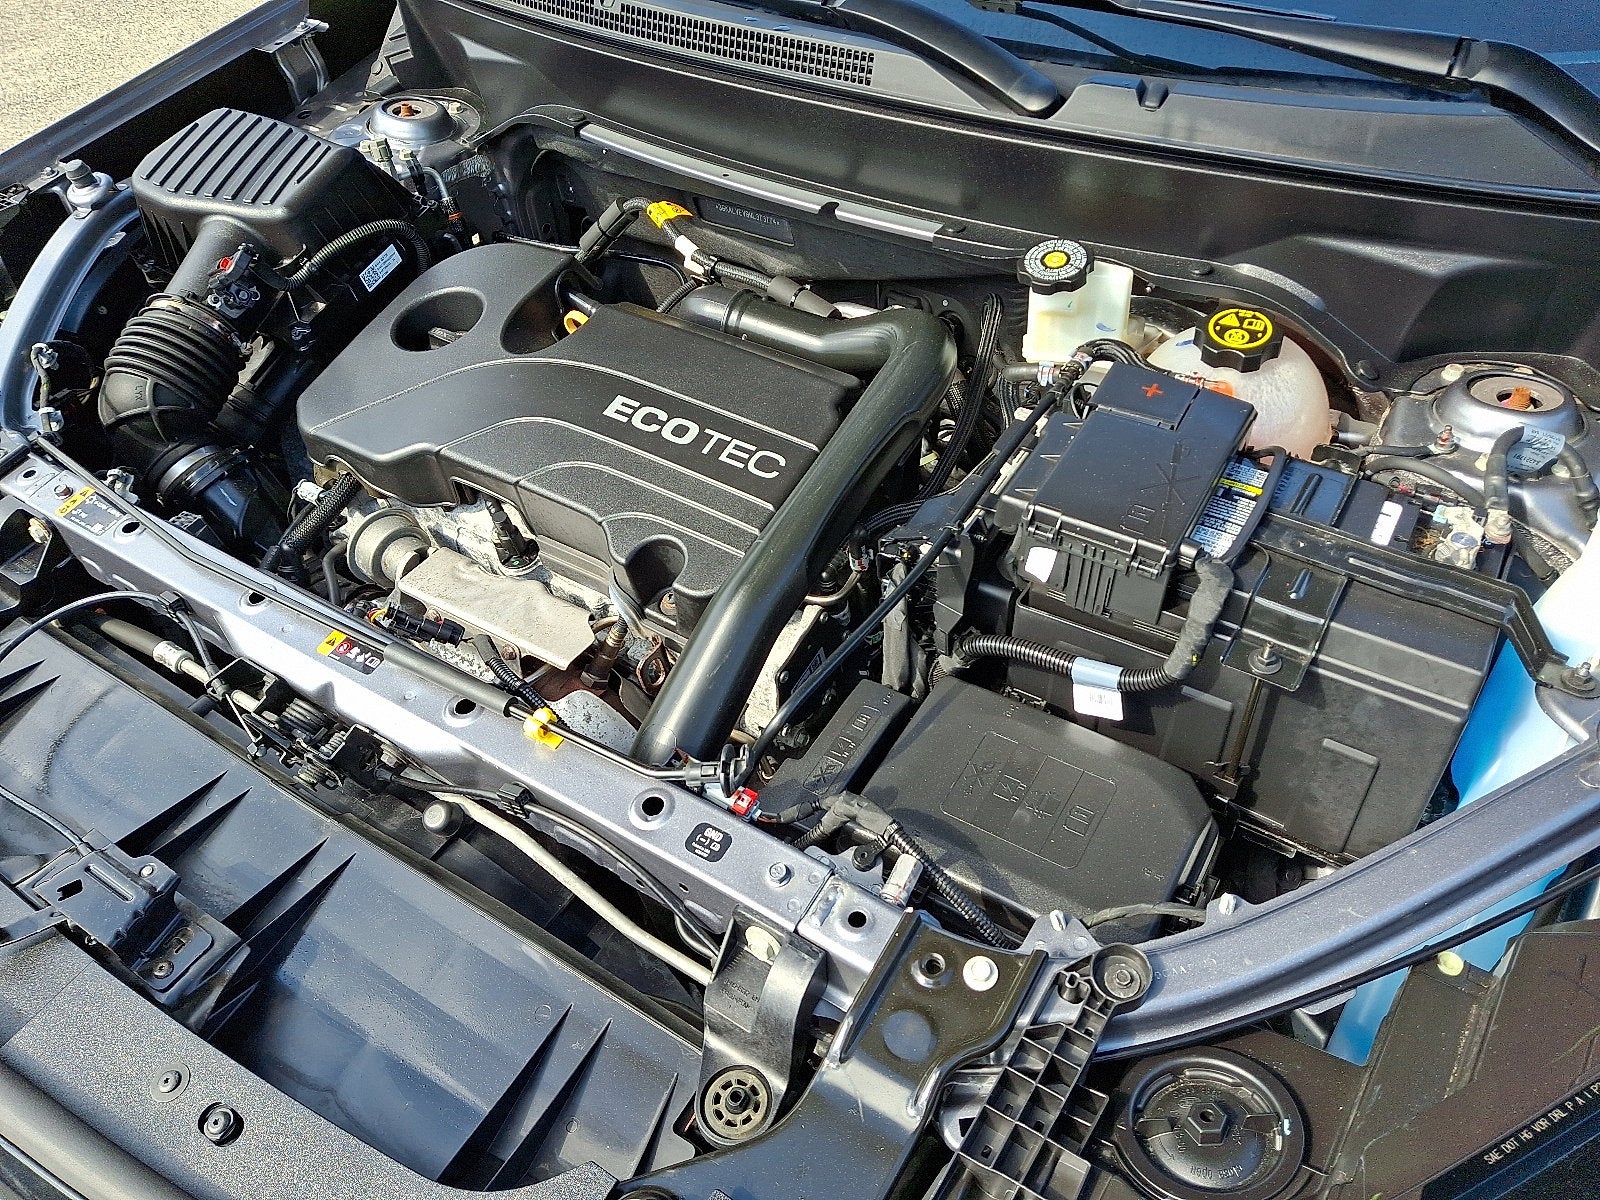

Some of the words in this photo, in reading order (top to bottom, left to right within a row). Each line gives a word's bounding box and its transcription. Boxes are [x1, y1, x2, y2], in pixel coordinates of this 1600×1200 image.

[602, 394, 787, 480] ECOTEC
[704, 827, 724, 842] GND
[1483, 1149, 1504, 1165] SAE
[1501, 1138, 1520, 1153] DOT
[1519, 1129, 1533, 1141] HG
[1531, 1117, 1551, 1132] VOR
[1548, 1108, 1568, 1122] DRL
[1565, 1101, 1575, 1111] P
[1574, 1095, 1586, 1105] A
[1190, 1165, 1213, 1180] open
